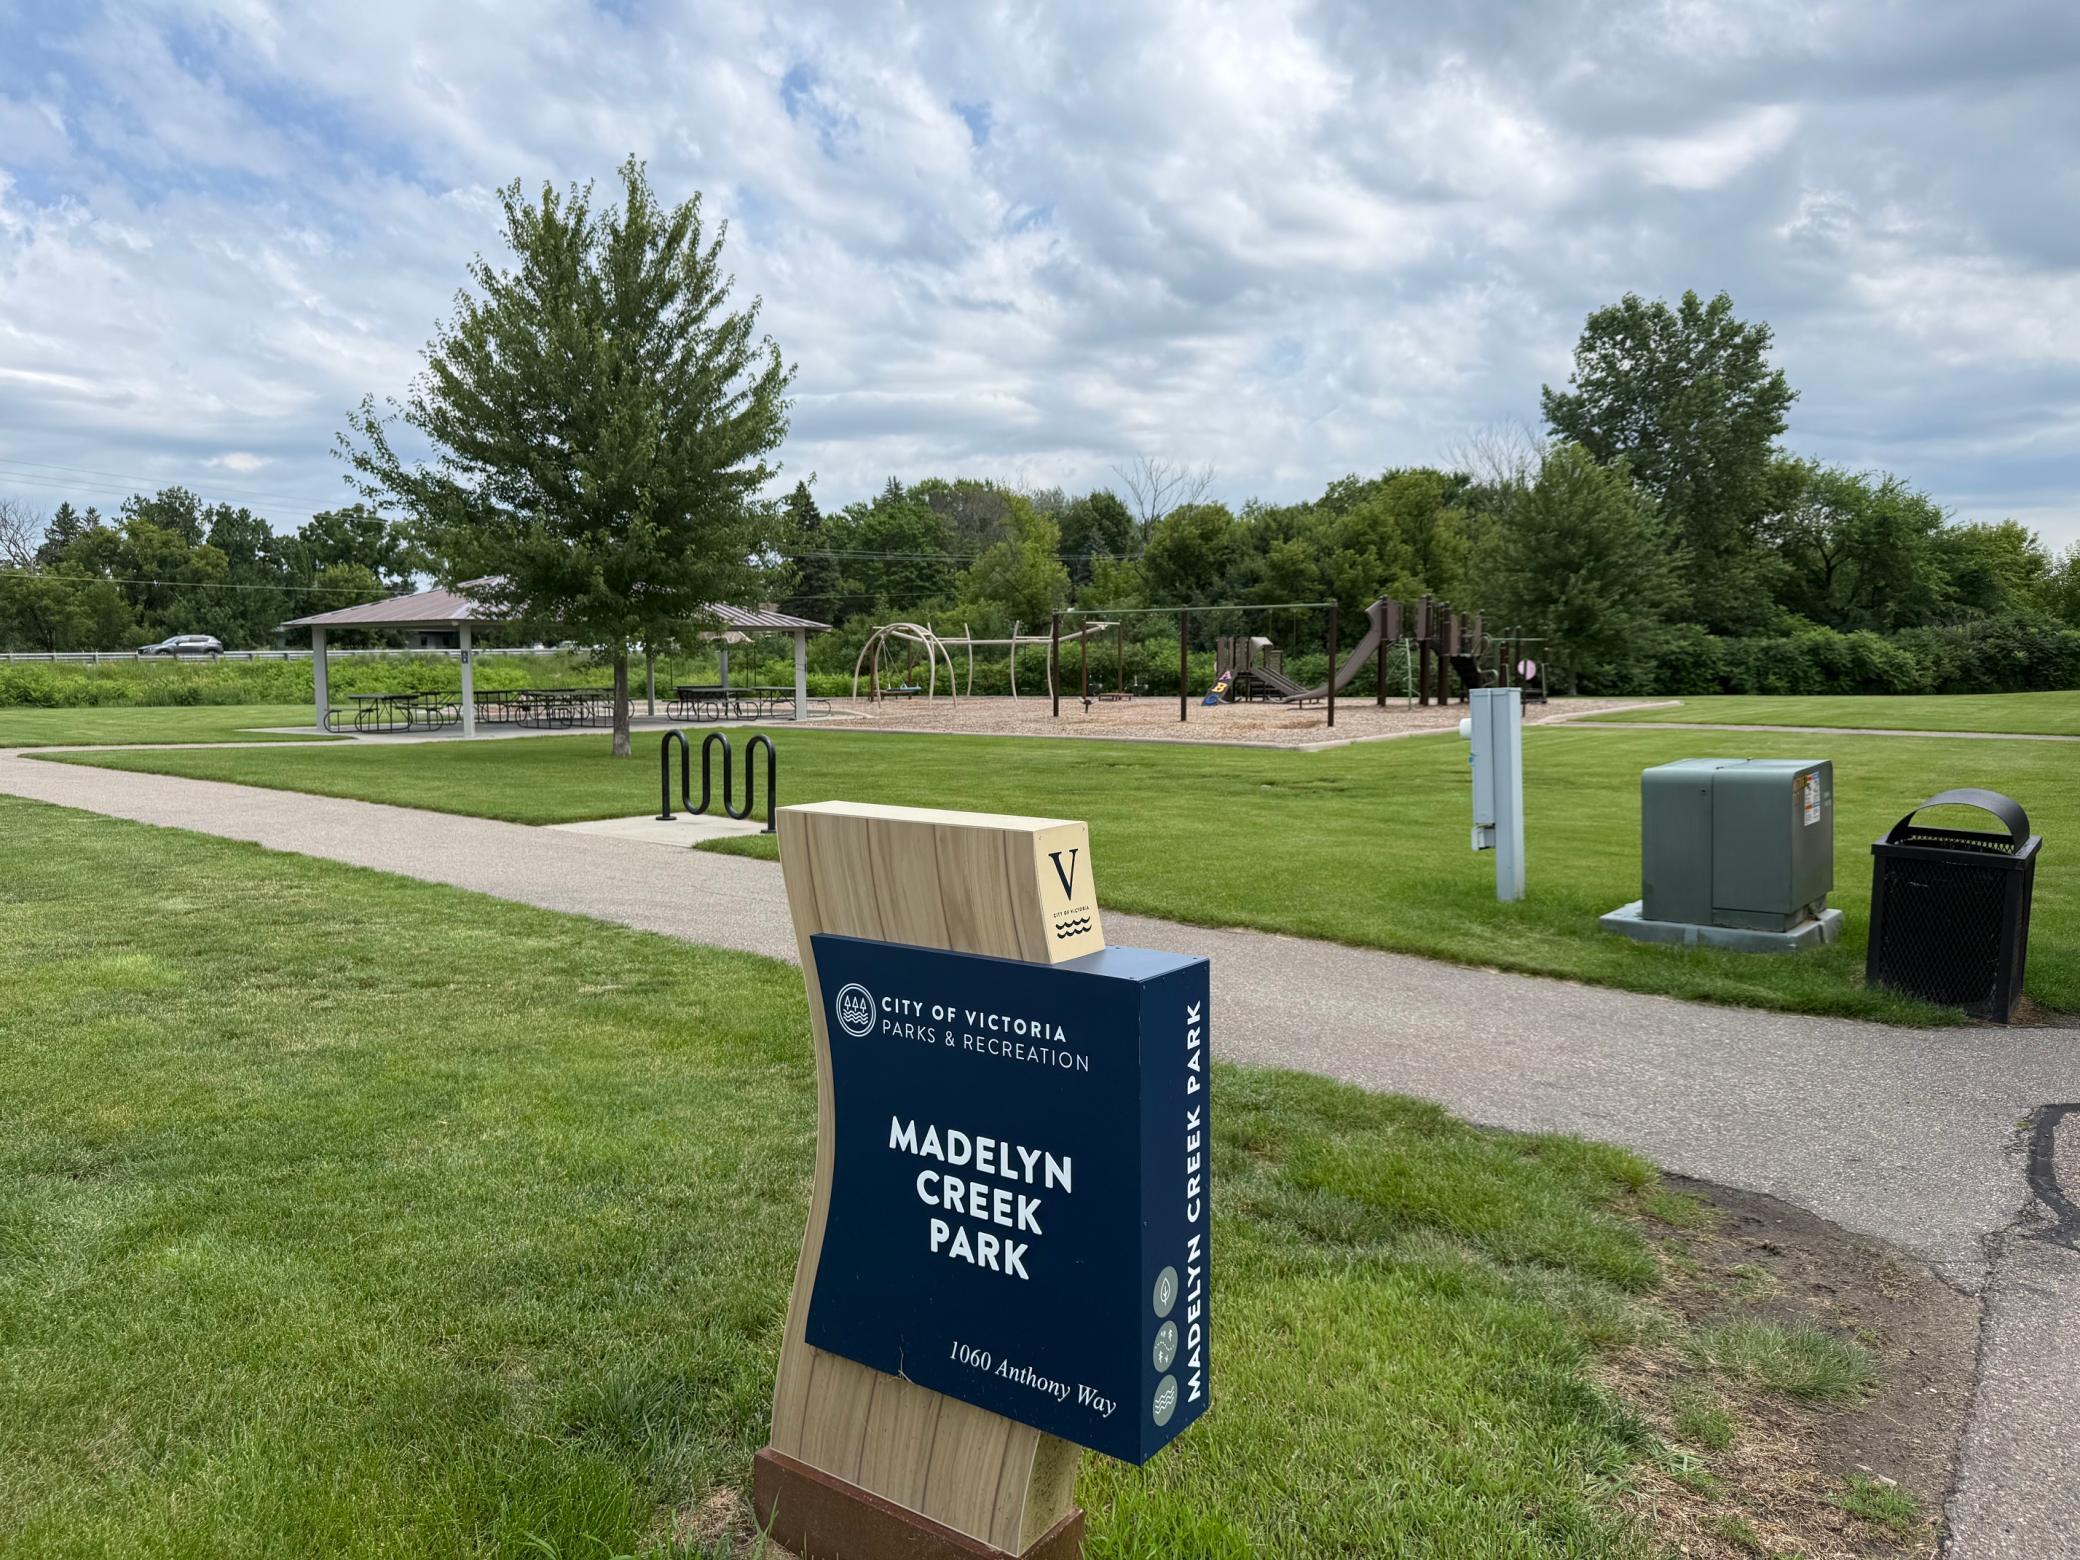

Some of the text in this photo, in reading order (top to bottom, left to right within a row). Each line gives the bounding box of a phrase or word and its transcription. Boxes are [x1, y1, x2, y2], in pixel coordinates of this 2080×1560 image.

[1210, 682, 1228, 693] B
[1048, 848, 1079, 901] V
[1070, 905, 1089, 914] VICTORIA
[881, 996, 1067, 1043] CITY OF VICTORIA
[882, 1019, 1090, 1073] PARKS & RECREATION
[888, 1115, 1072, 1194] MADELYN
[916, 1169, 1043, 1236] CREEK
[1186, 1000, 1202, 1403] MADELYN CREEK PARK
[930, 1217, 1030, 1281] PARK
[949, 1341, 1117, 1419] 1060 Anthony Way
